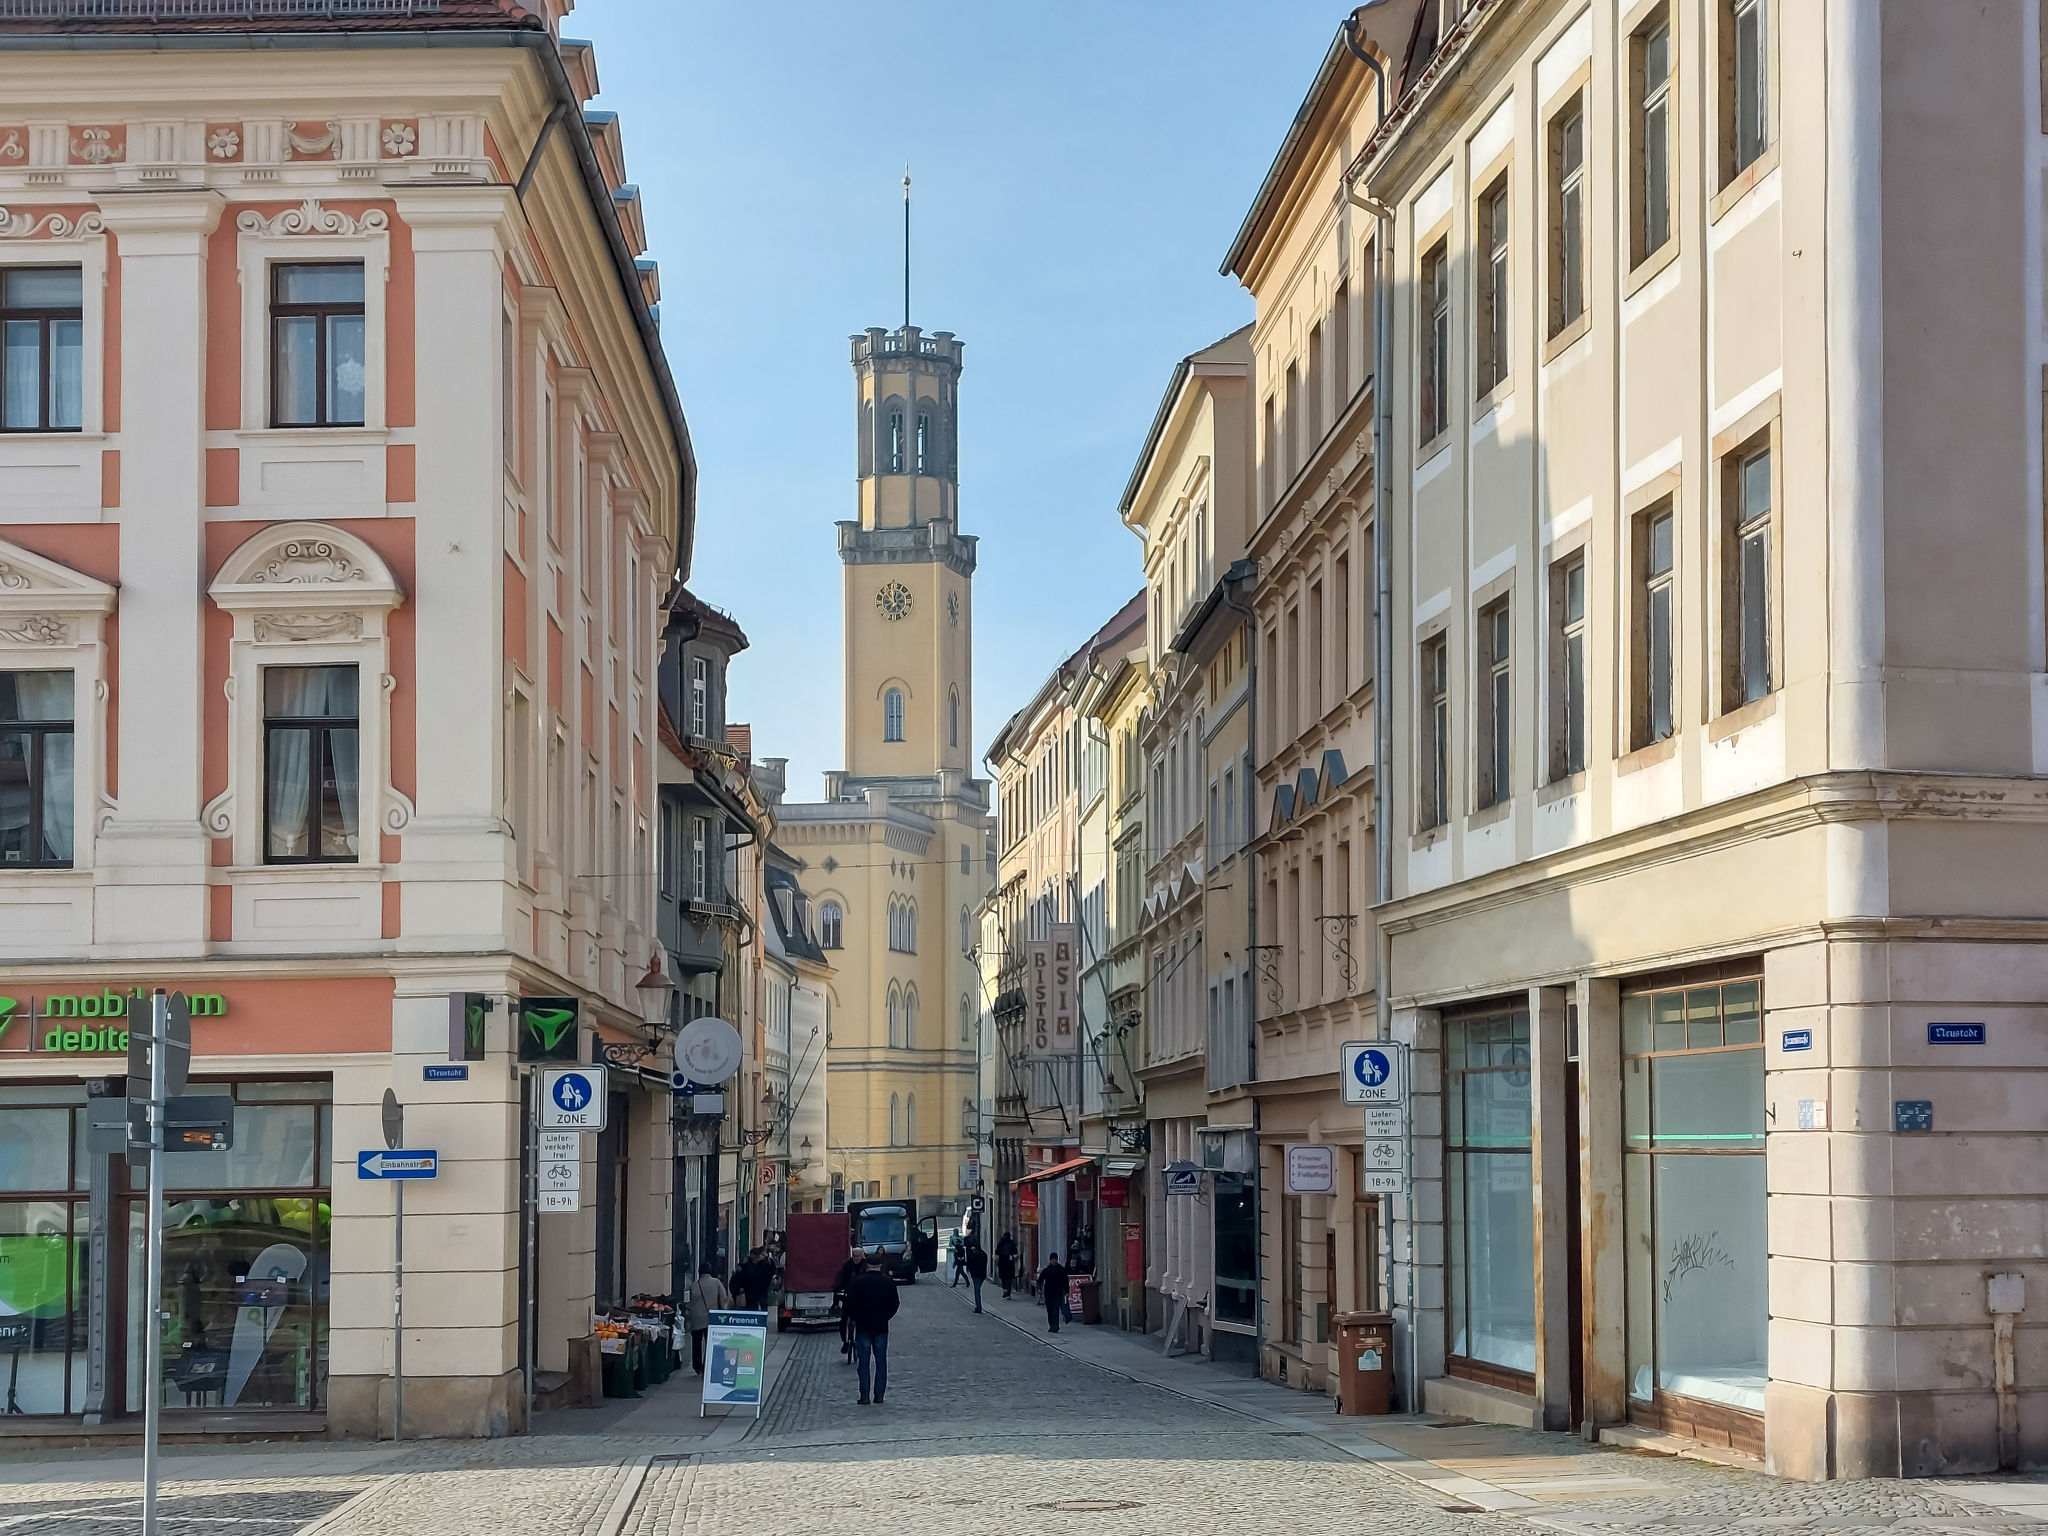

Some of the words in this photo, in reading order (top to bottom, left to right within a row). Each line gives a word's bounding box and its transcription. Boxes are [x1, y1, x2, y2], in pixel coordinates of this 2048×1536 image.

[1056, 942, 1072, 1036] ASIA
[1034, 952, 1048, 1049] BISTRO
[1935, 1027, 1978, 1038] Neustadt
[428, 1068, 462, 1077] Neustadt
[1359, 1088, 1387, 1099] ZONE
[1371, 1110, 1396, 1118] Liefer-
[557, 1114, 587, 1124] ZONE
[1369, 1119, 1398, 1127] verkehr
[1377, 1127, 1391, 1135] frei
[546, 1134, 574, 1142] Liefer-
[544, 1142, 575, 1151] verkehr
[553, 1151, 567, 1159] frei
[1377, 1158, 1391, 1166] frei
[553, 1180, 567, 1188] frei
[1371, 1177, 1396, 1187] 18-9h
[546, 1196, 572, 1207] 18-9h
[728, 1316, 759, 1325] freenet
